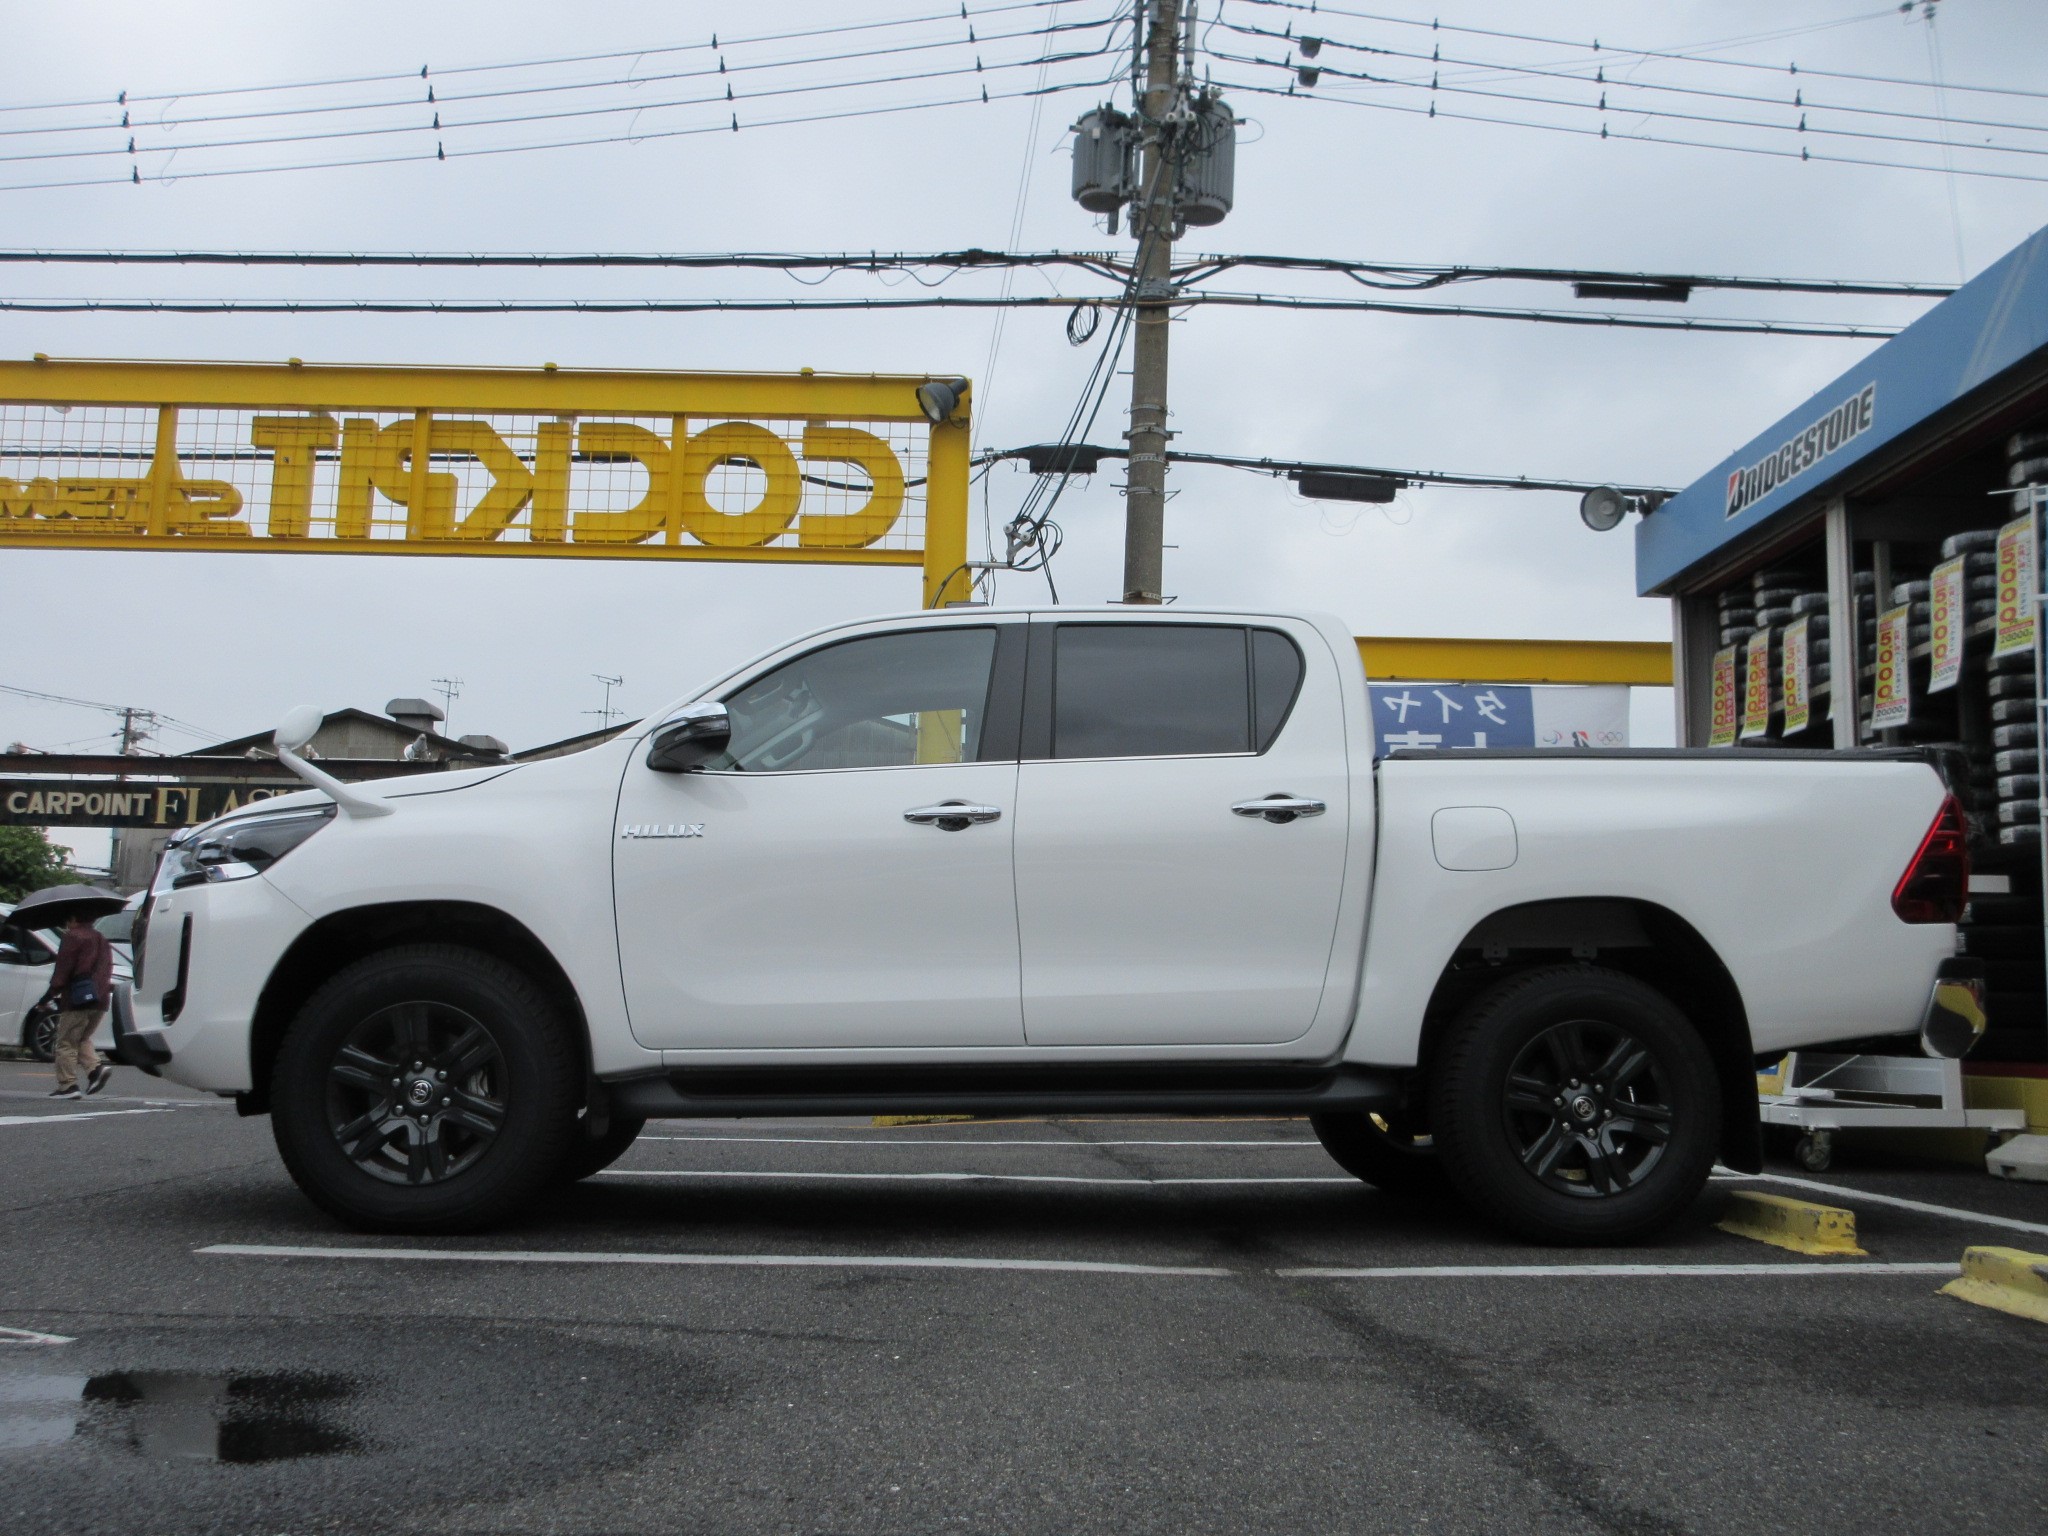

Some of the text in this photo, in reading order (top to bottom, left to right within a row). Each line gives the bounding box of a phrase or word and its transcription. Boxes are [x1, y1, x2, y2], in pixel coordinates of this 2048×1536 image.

[1726, 385, 1875, 518] BRIDGESTONE
[7, 791, 151, 816] CARPOINT
[621, 824, 704, 838] HILUX
